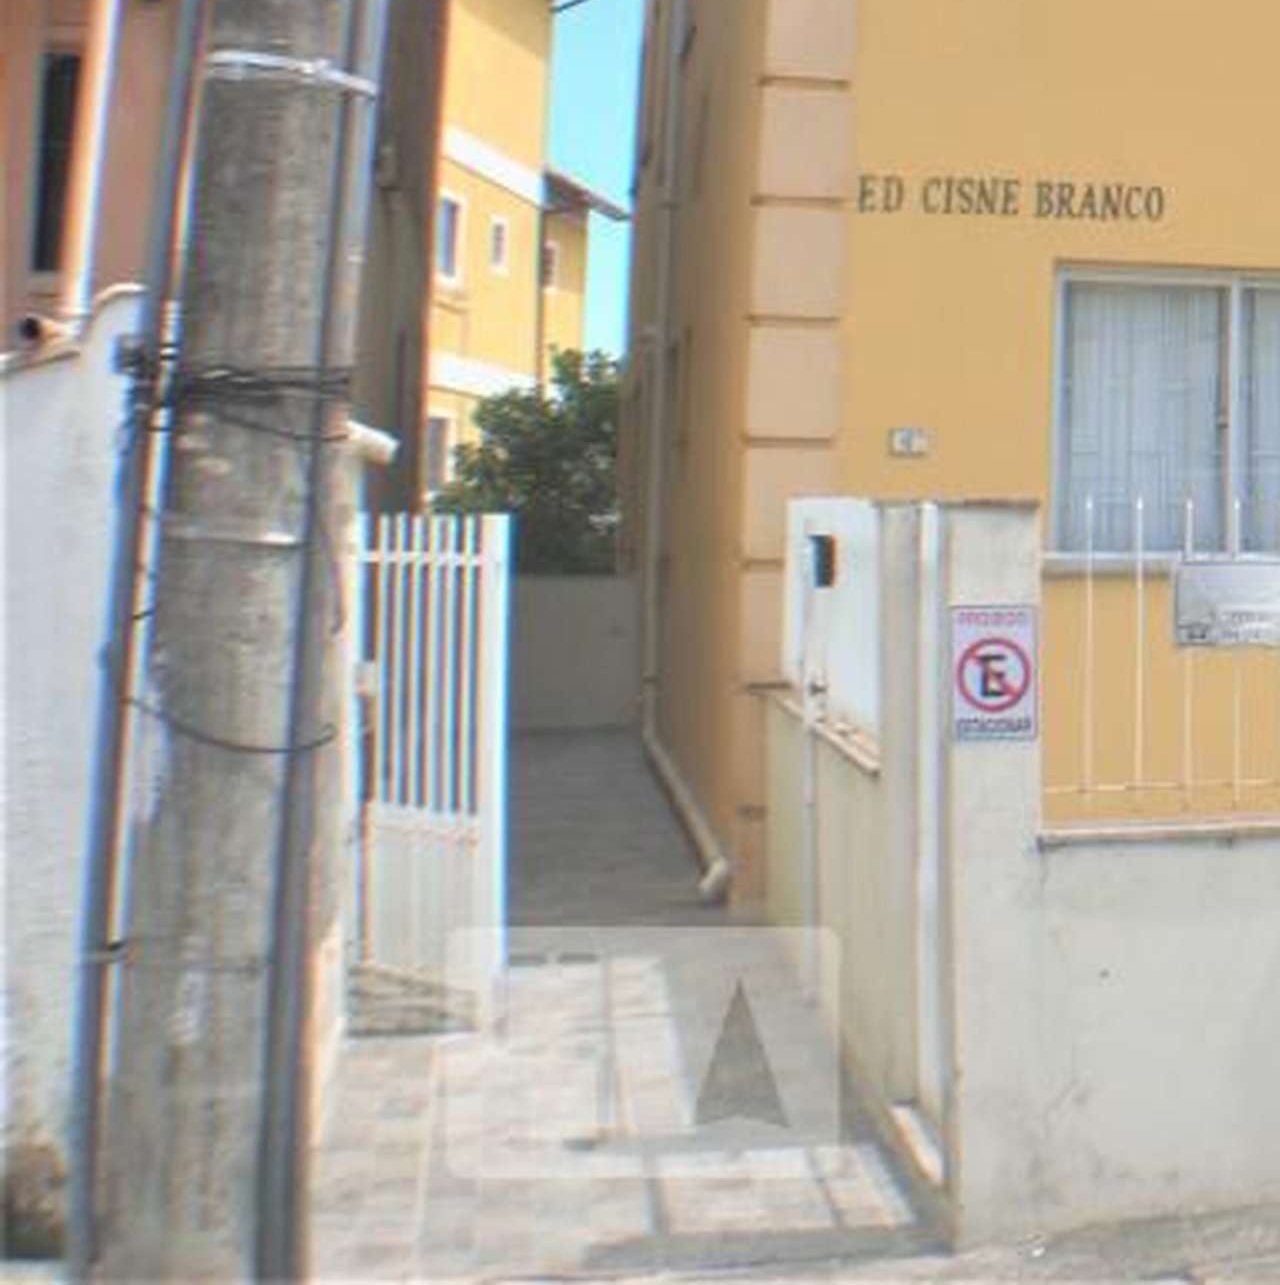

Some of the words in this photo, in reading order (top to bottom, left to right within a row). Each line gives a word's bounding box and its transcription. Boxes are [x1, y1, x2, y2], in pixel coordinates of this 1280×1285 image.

[857, 174, 904, 214] ED
[921, 176, 1020, 216] CISNE
[1033, 180, 1166, 222] BRANCO
[978, 653, 1006, 698] E
